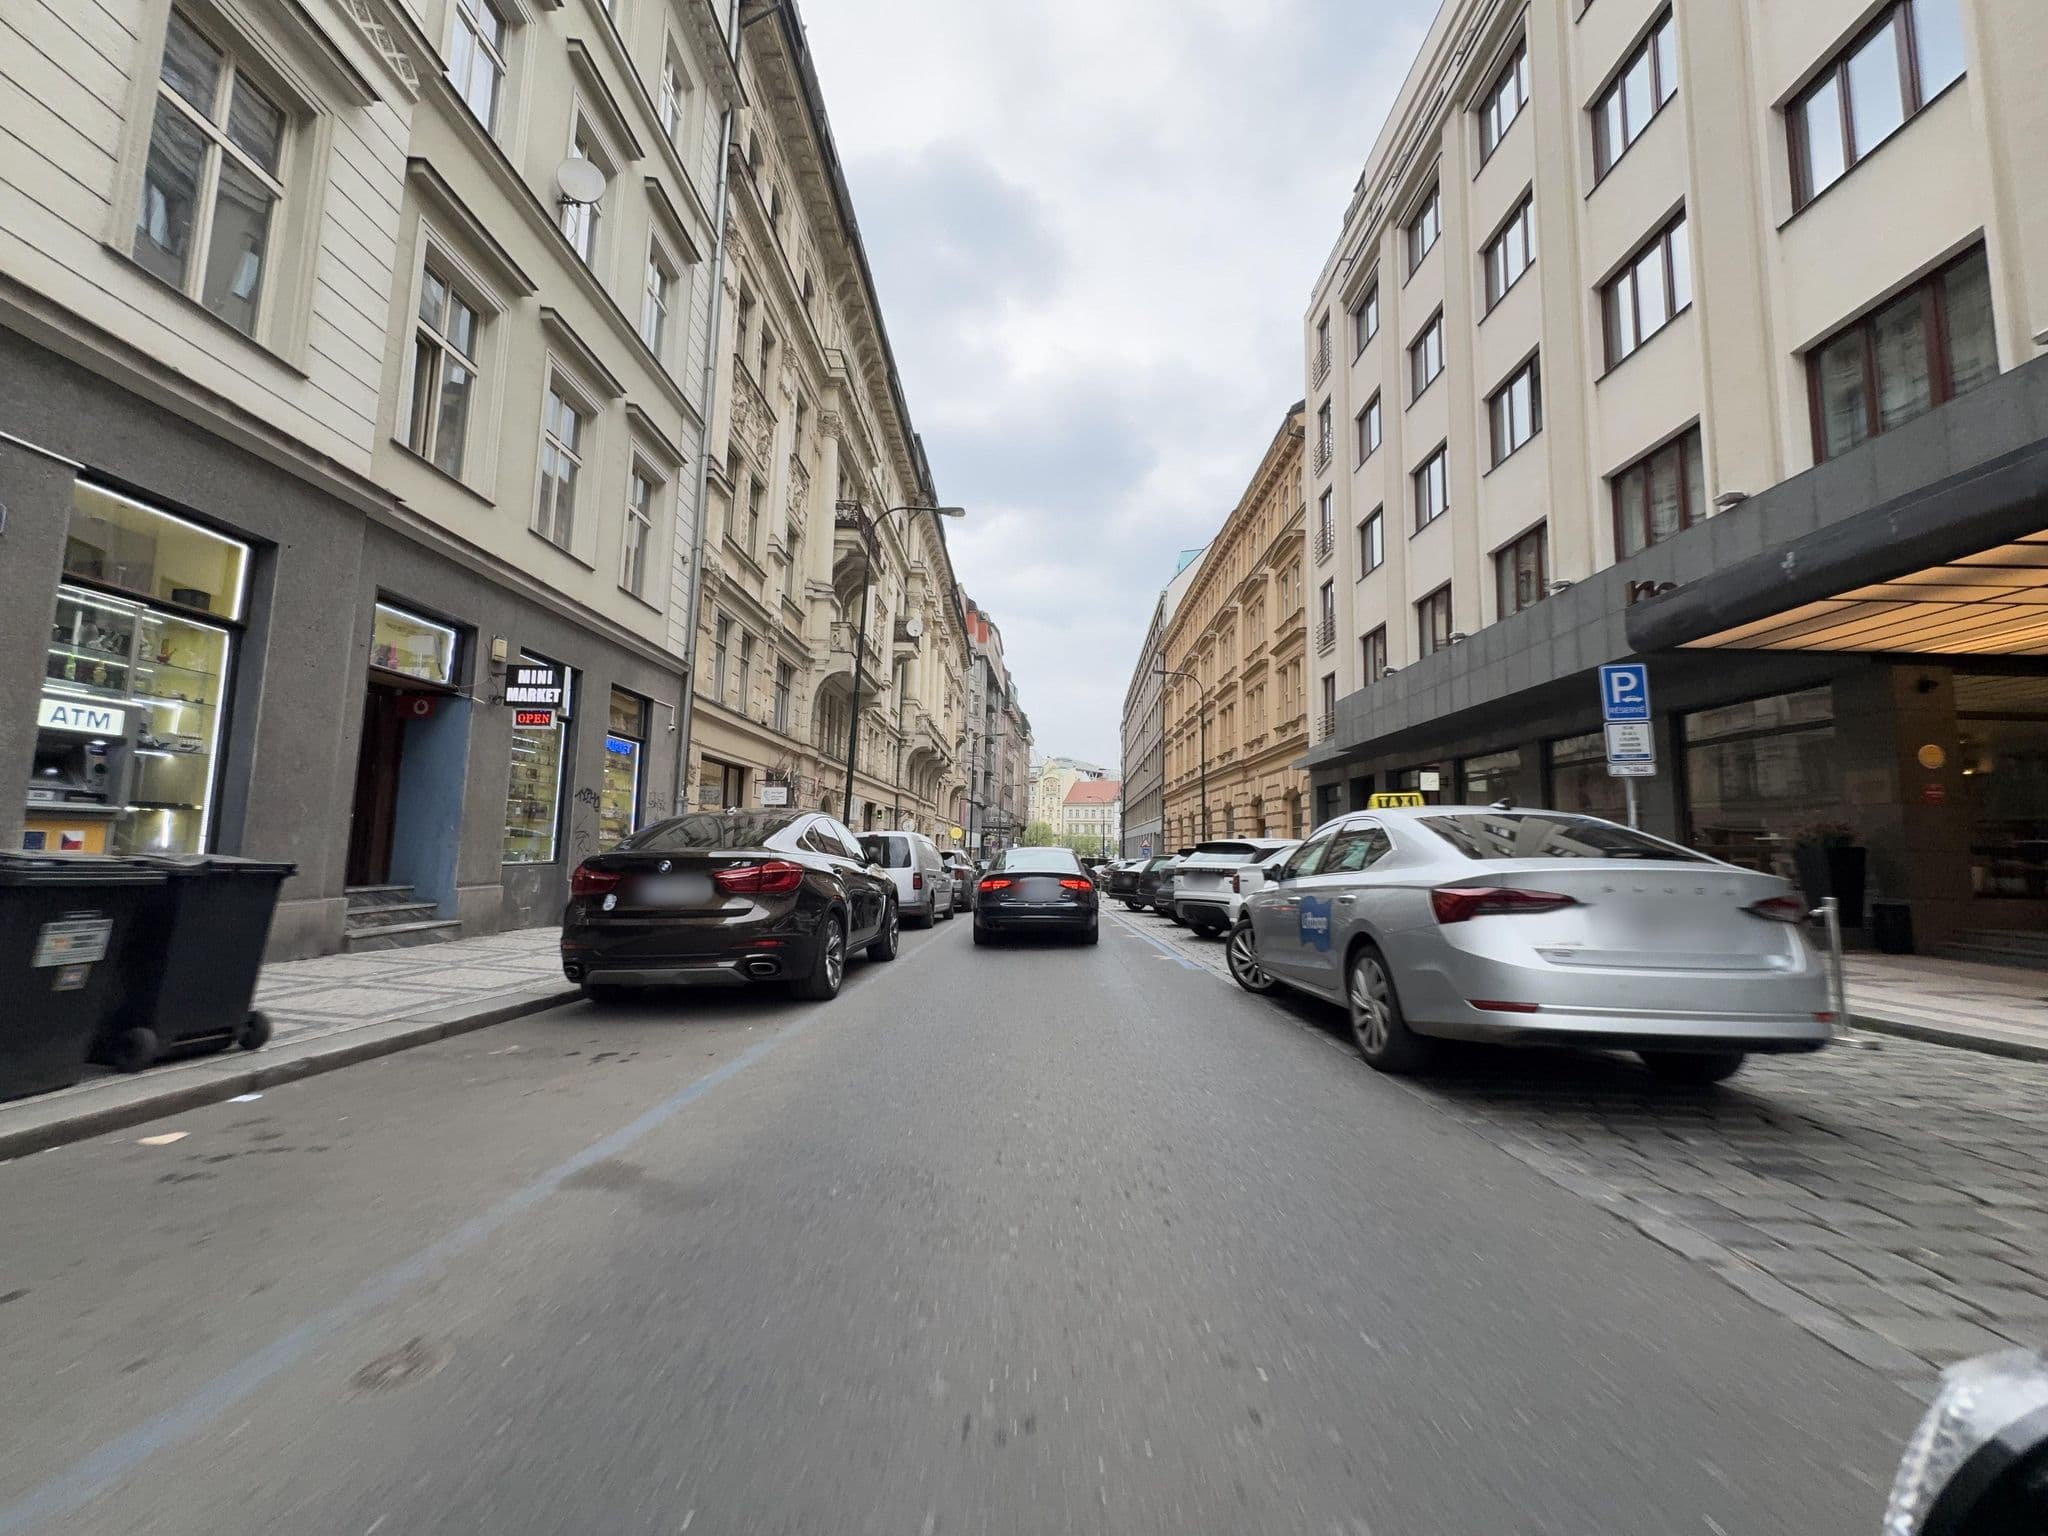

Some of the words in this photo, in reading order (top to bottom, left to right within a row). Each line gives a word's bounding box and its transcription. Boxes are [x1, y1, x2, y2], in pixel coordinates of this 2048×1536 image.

[518, 669, 553, 684] MINI
[506, 687, 561, 703] MARKET
[1611, 672, 1638, 703] P
[50, 706, 110, 730] ATM
[518, 713, 550, 724] OPEN
[1378, 796, 1418, 808] TAXI
